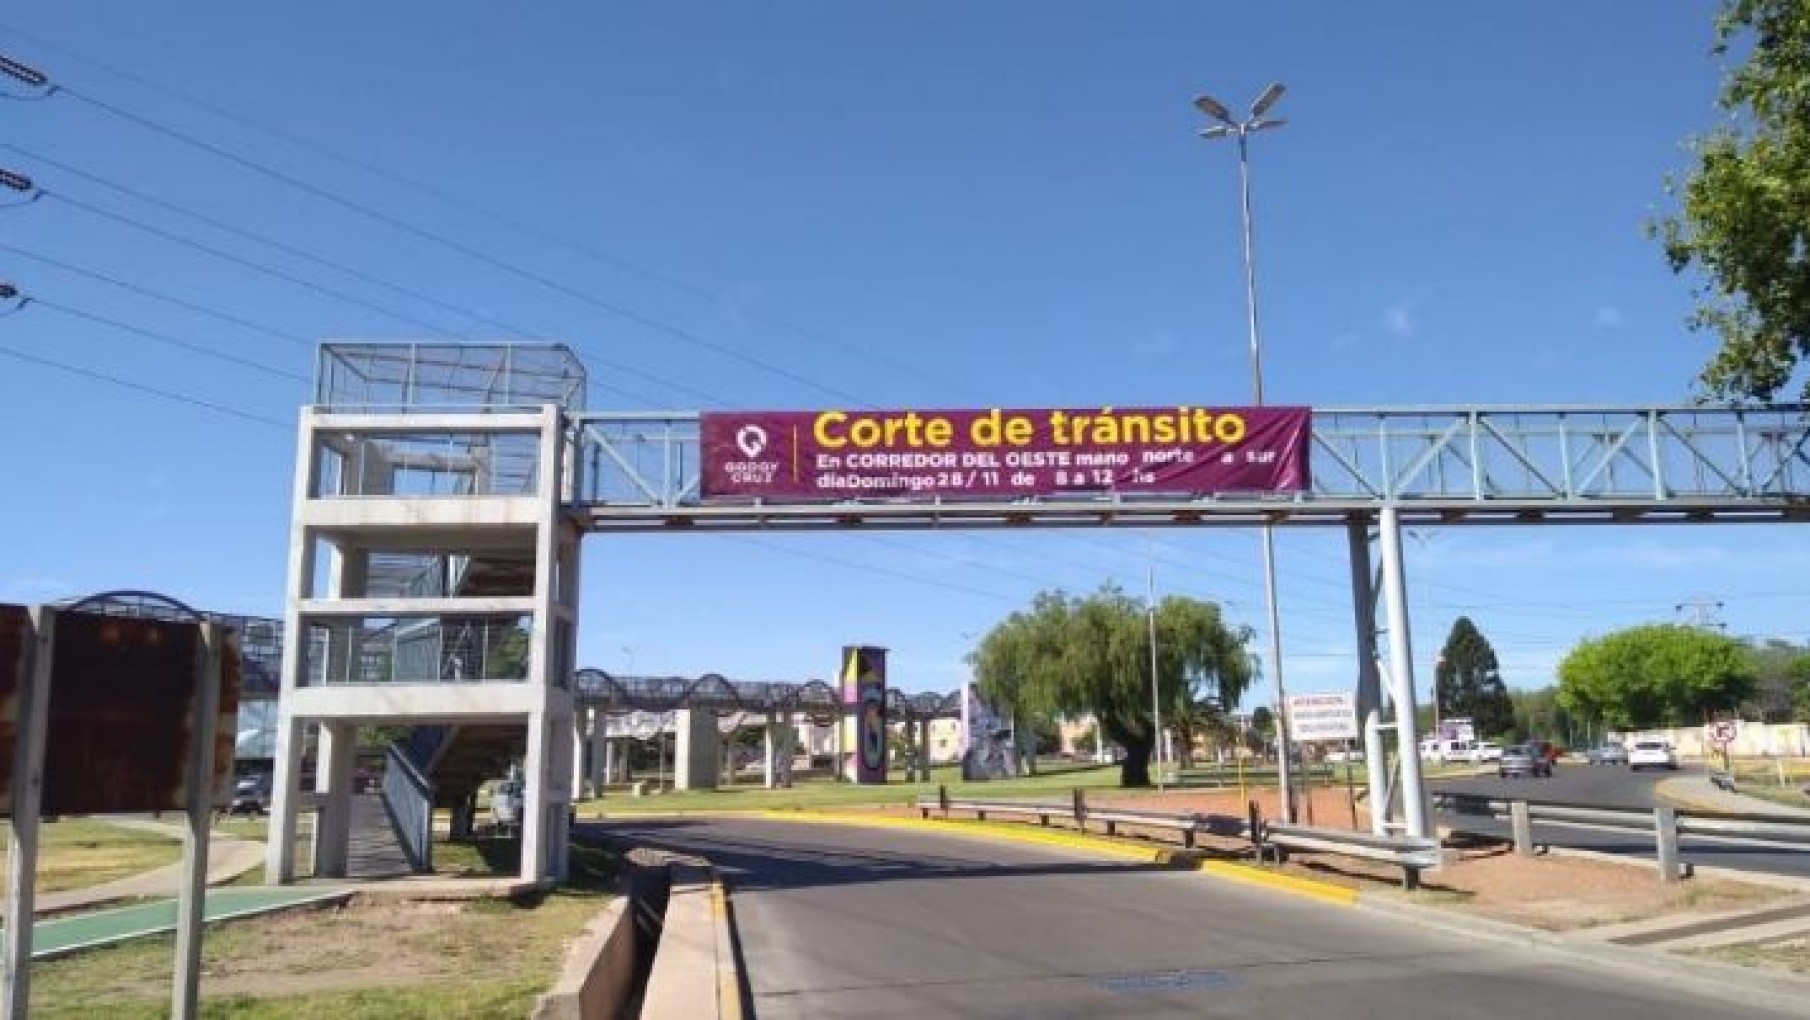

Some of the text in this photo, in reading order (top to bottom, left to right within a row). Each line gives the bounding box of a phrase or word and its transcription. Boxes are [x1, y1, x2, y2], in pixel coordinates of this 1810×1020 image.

[814, 406, 1245, 447] Corte de tránsito
[816, 454, 840, 468] En
[846, 452, 957, 468] CORREDOR
[962, 452, 1000, 467] DEL
[1006, 451, 1070, 466] OESTE
[1076, 453, 1129, 466] mano
[1142, 448, 1194, 463] norte
[1010, 471, 1035, 486] de
[1055, 471, 1068, 485] 8
[1073, 472, 1085, 485] a
[1092, 469, 1113, 484] 12
